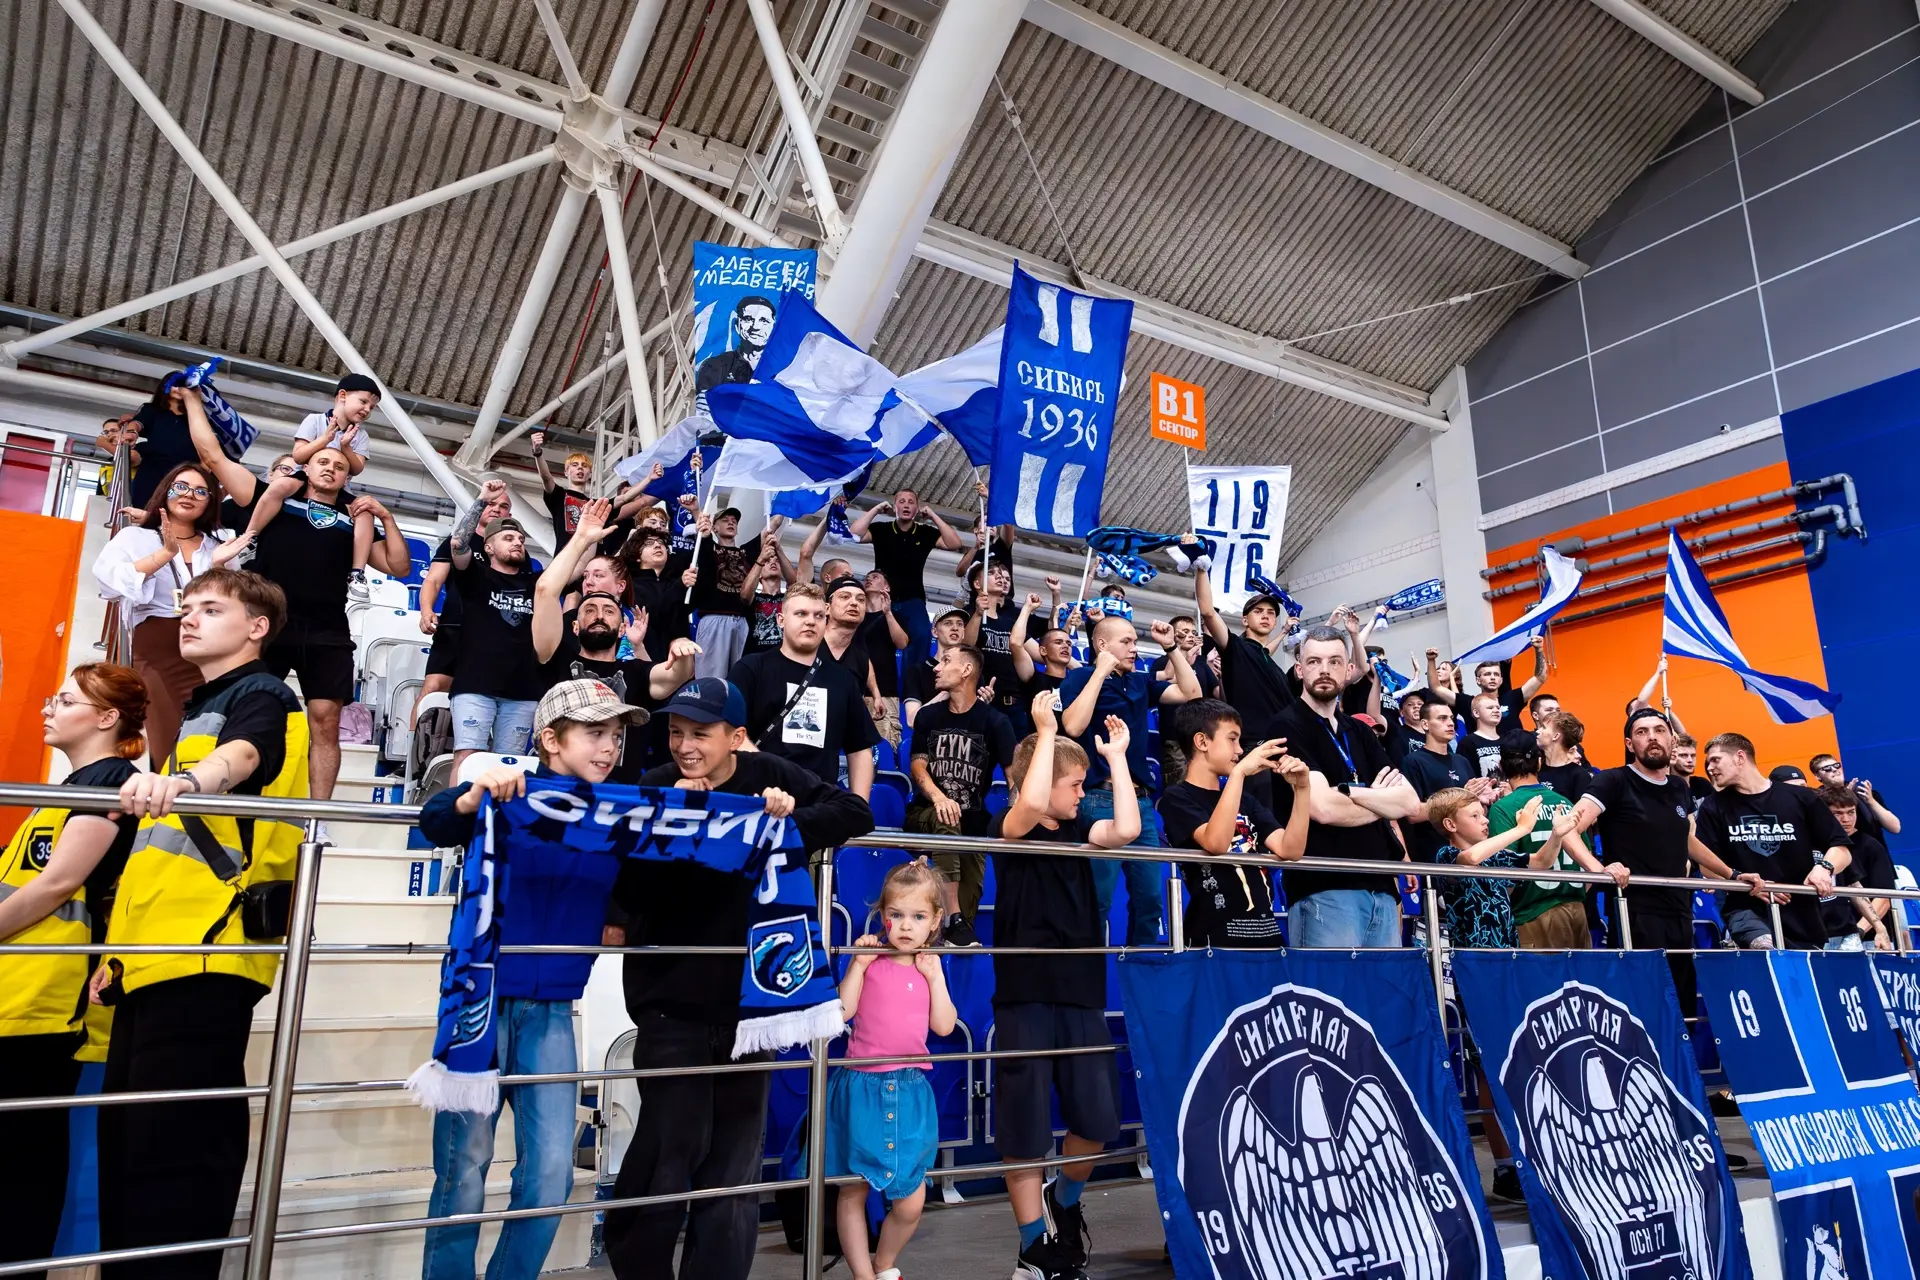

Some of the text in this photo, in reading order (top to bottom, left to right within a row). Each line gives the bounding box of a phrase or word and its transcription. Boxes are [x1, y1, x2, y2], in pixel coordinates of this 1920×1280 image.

[710, 256, 810, 280] АЛЕКСЕЙ
[1017, 360, 1105, 404] СИБИРЬ
[1017, 398, 1098, 451] 1936
[1159, 419, 1199, 440] СЕКТОР
[488, 599, 512, 611] FROM
[678, 690, 701, 700] adidas
[936, 734, 972, 763] GYM
[1728, 822, 1795, 836] ULTRAS
[1729, 834, 1797, 842] FROM SIBERIA
[36, 841, 53, 860] 39
[411, 866, 421, 889] РЯД
[1729, 986, 1868, 1039] 19 36
[1753, 1107, 1876, 1173] NOVOSIBIRSK
[1683, 1133, 1717, 1172] 36
[1197, 1171, 1457, 1257] 19 36
